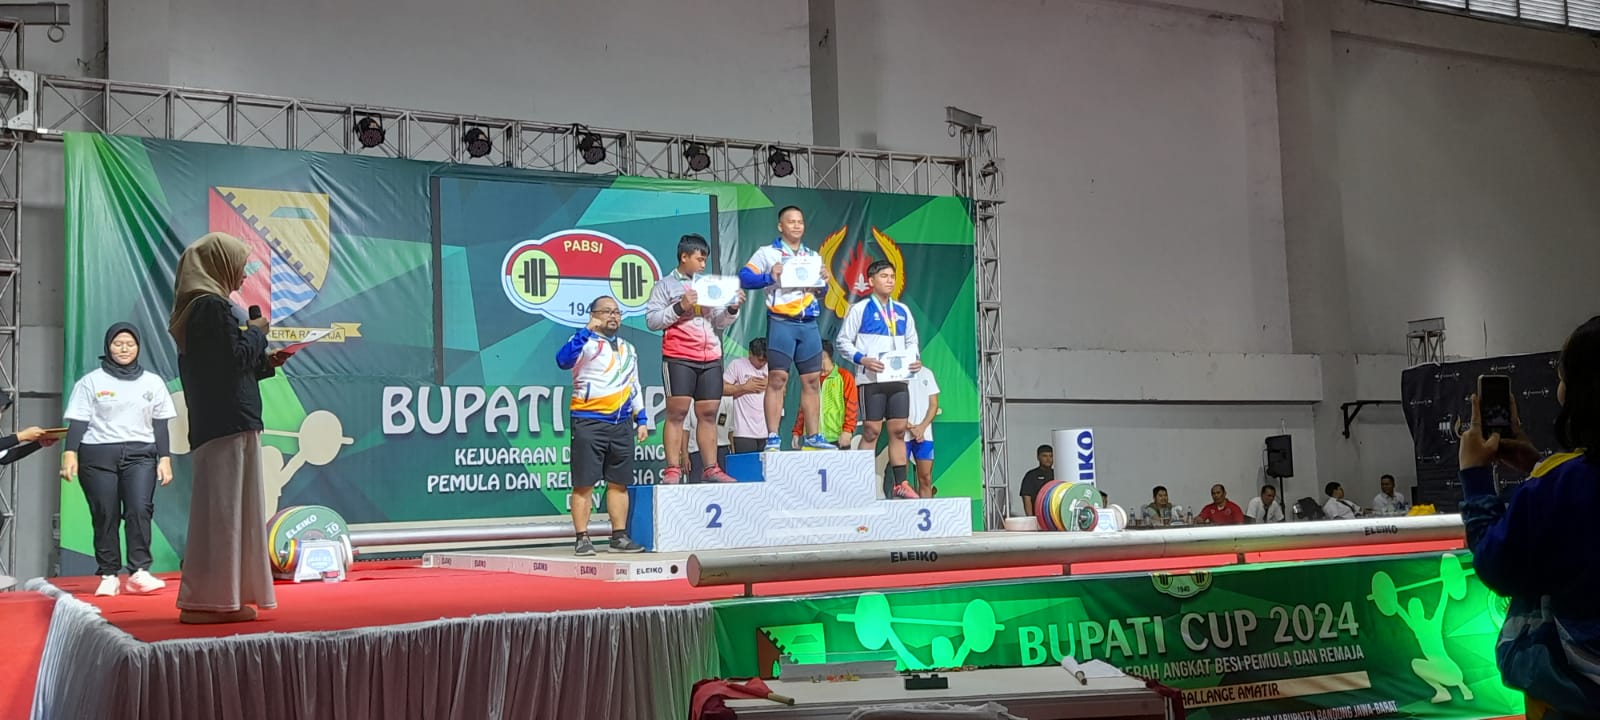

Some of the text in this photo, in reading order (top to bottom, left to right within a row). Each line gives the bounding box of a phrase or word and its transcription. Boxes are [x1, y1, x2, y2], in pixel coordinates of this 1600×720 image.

[564, 239, 603, 254] PABSI
[569, 302, 592, 316] 194
[268, 330, 296, 339] ERTA
[382, 386, 565, 434] BUPATI
[455, 448, 557, 466] KEJUARAAN
[427, 474, 500, 493] PEMULA
[505, 472, 541, 490] DAN
[817, 469, 828, 493] 1
[706, 503, 722, 528] 2
[917, 508, 932, 531] 3
[286, 514, 317, 539] ELEIKO
[326, 522, 339, 534] 10
[1364, 525, 1398, 536] ELEIKO
[890, 551, 938, 563] ELEIKO
[636, 567, 663, 575] ELEIKO
[1018, 601, 1359, 666] BUPATI CUP 2024
[1164, 658, 1211, 679] ANGKAT
[1293, 649, 1318, 666] DAN
[1320, 644, 1364, 662] REMAJA
[1181, 682, 1279, 706] HALLANGE AMATIR
